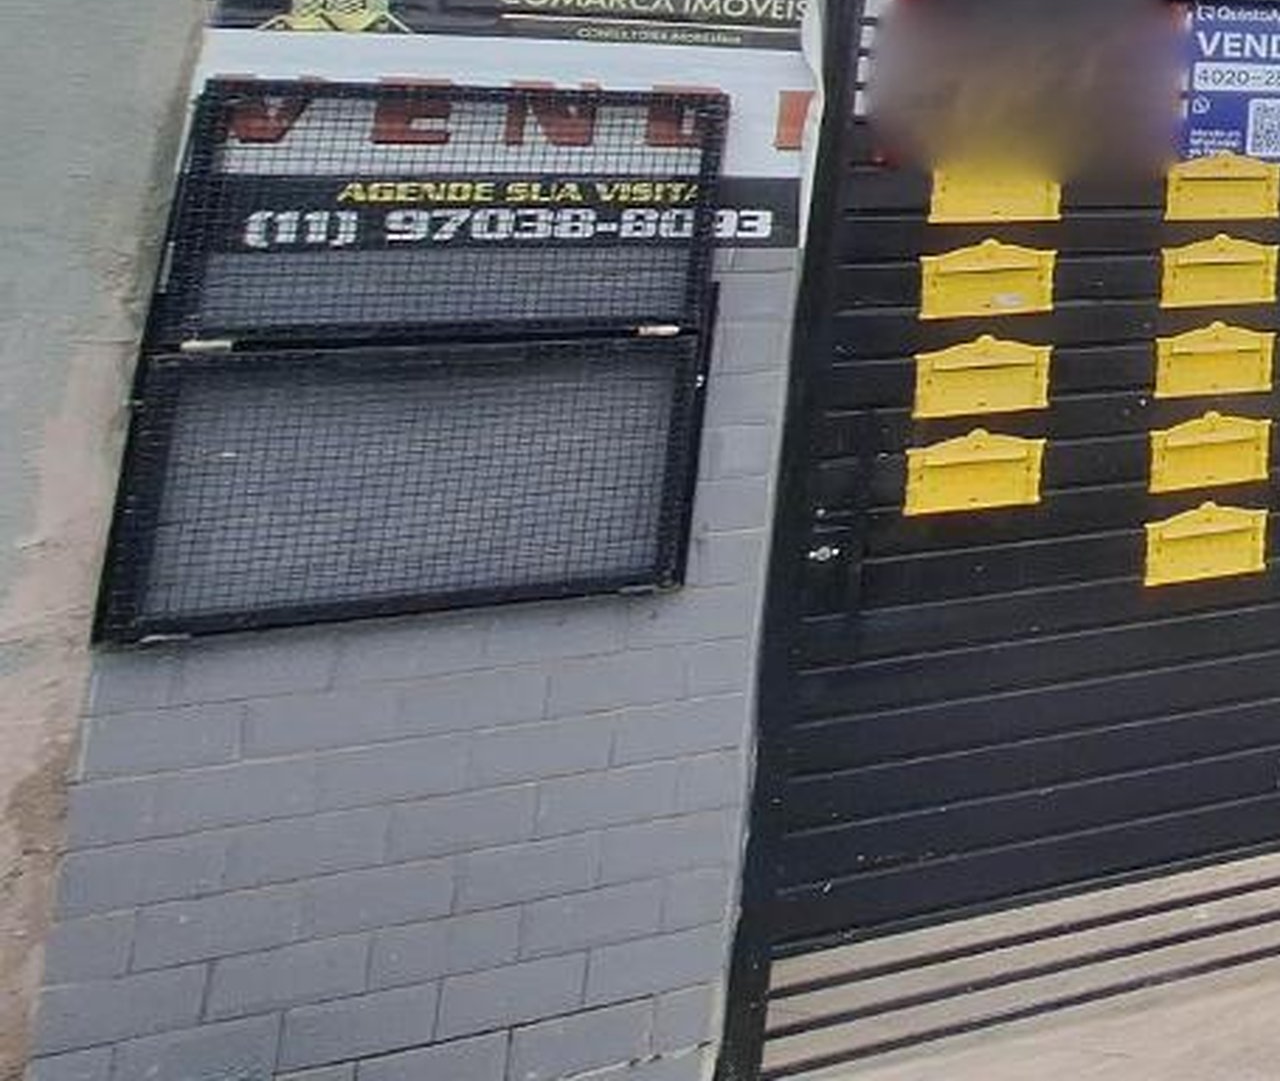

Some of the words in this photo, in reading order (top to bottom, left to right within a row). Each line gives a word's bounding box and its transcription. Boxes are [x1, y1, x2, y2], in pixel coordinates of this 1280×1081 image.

[336, 182, 493, 203] AGENDE
[503, 182, 584, 203] SUA
[244, 209, 358, 248] (11)
